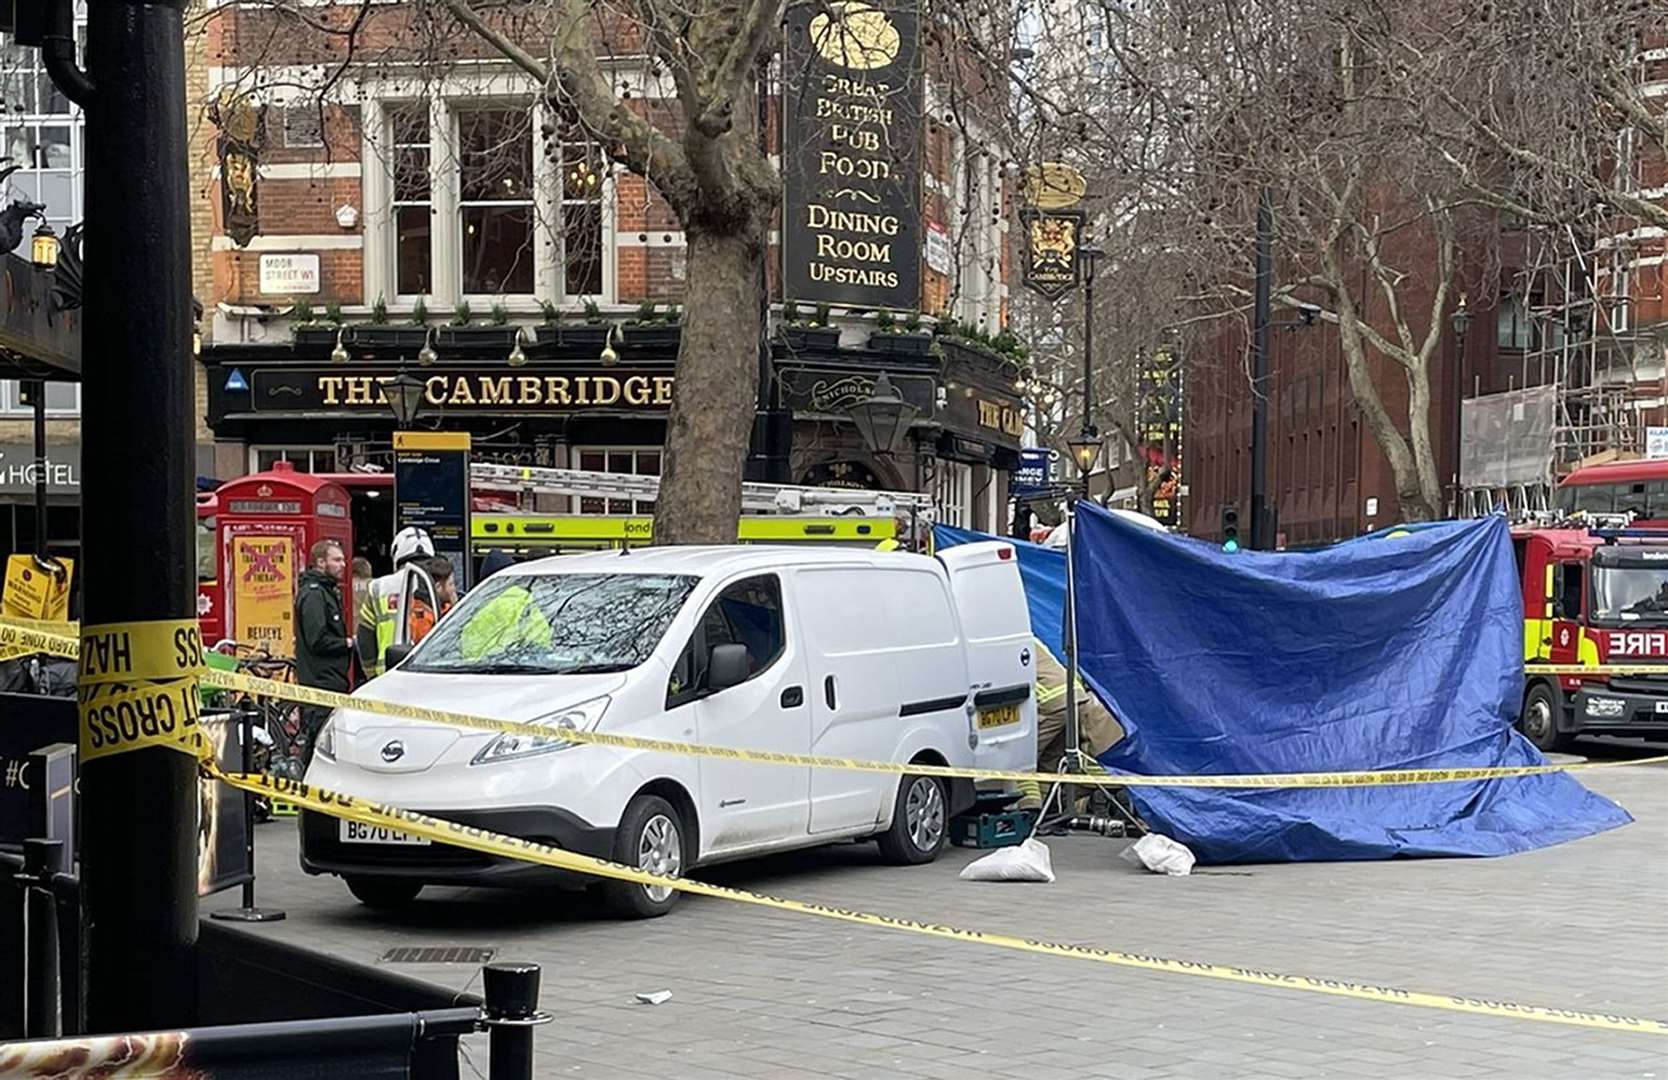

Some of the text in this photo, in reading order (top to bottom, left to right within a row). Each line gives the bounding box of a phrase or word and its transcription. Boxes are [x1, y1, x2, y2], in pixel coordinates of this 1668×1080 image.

[832, 124, 880, 151] PUB
[819, 151, 889, 179] FOOD
[807, 204, 899, 236] DINING
[816, 234, 891, 263] ROOM
[265, 269, 314, 281] STREET W1
[809, 262, 899, 288] UPSTAIRS
[425, 376, 675, 405] CAMBRIDGE
[980, 400, 999, 430] THE
[246, 626, 283, 641] BELIEVE
[86, 692, 176, 749] CROSS
